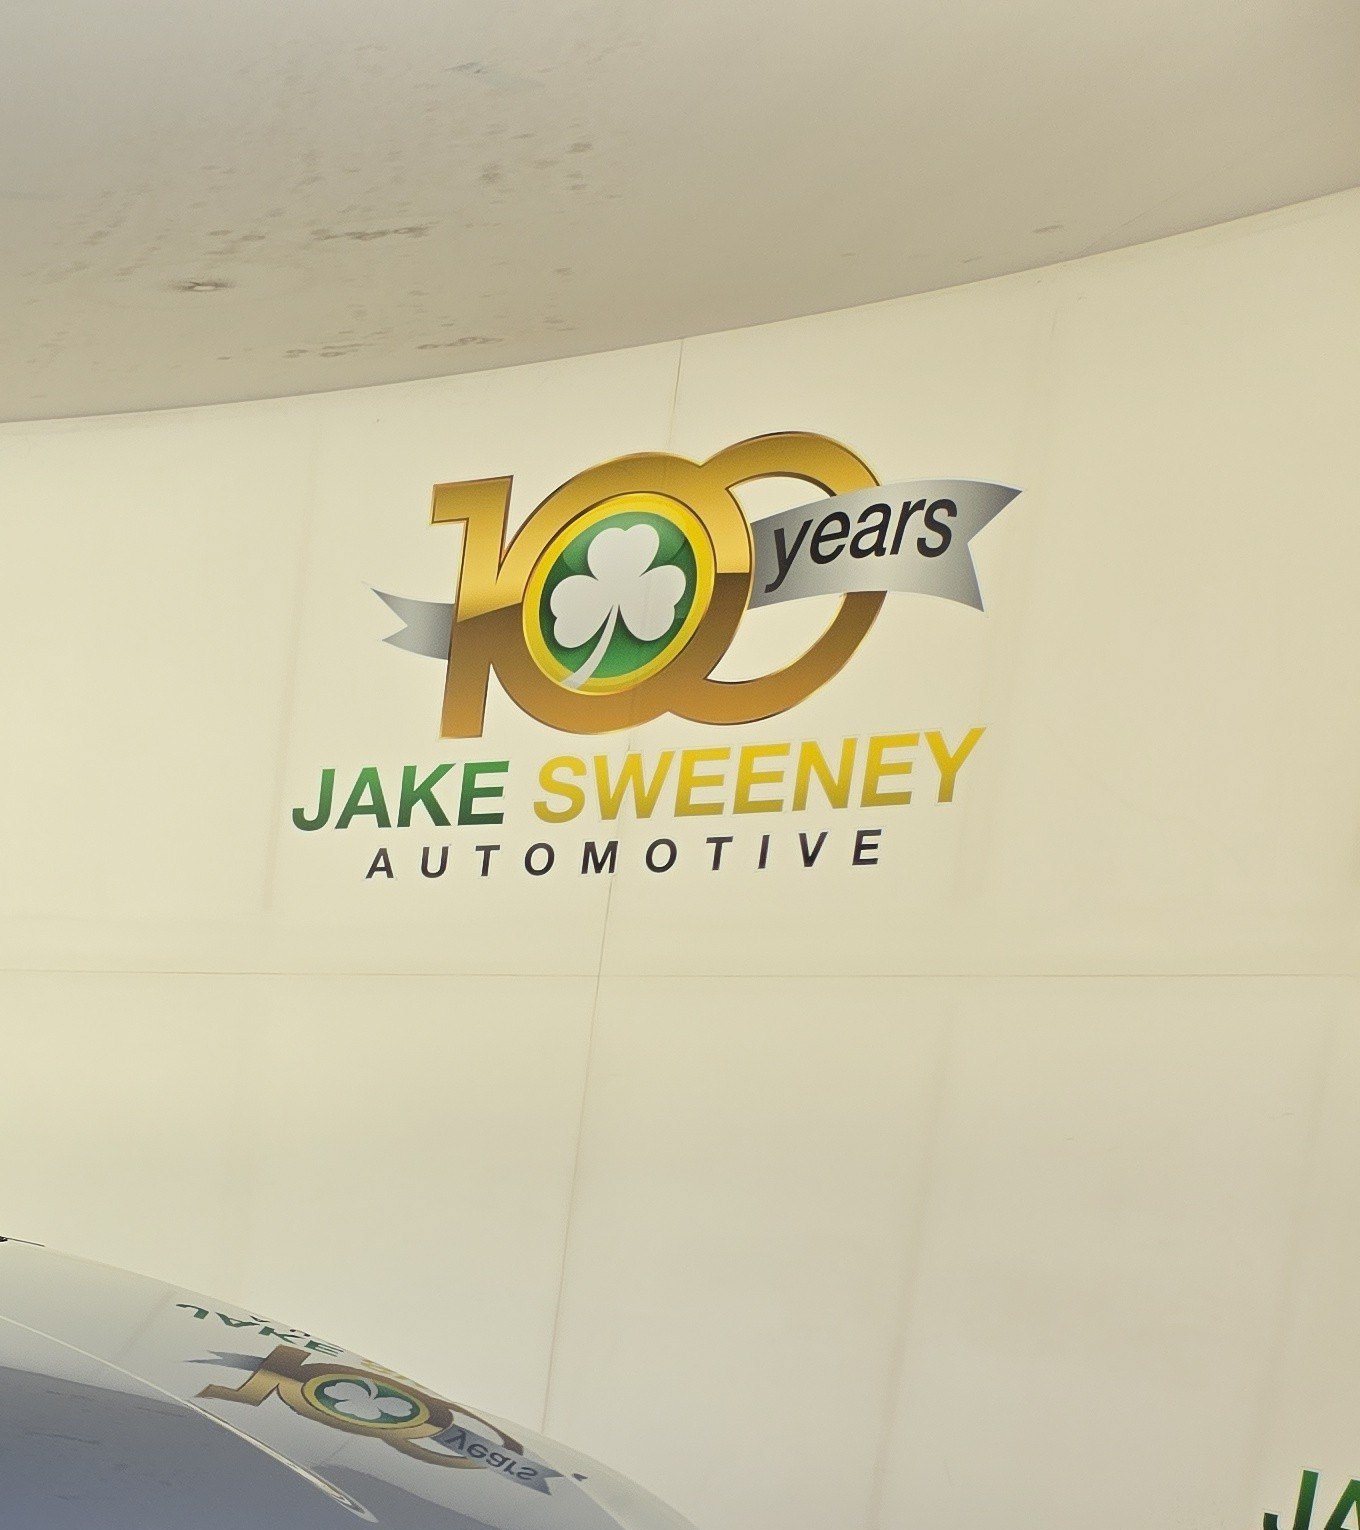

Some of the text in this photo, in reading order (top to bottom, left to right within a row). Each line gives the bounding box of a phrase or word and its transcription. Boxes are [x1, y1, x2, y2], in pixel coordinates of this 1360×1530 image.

[765, 497, 958, 594] years
[292, 727, 987, 832] JAKE SWEENEY
[366, 829, 885, 880] AUTOMOTIVE
